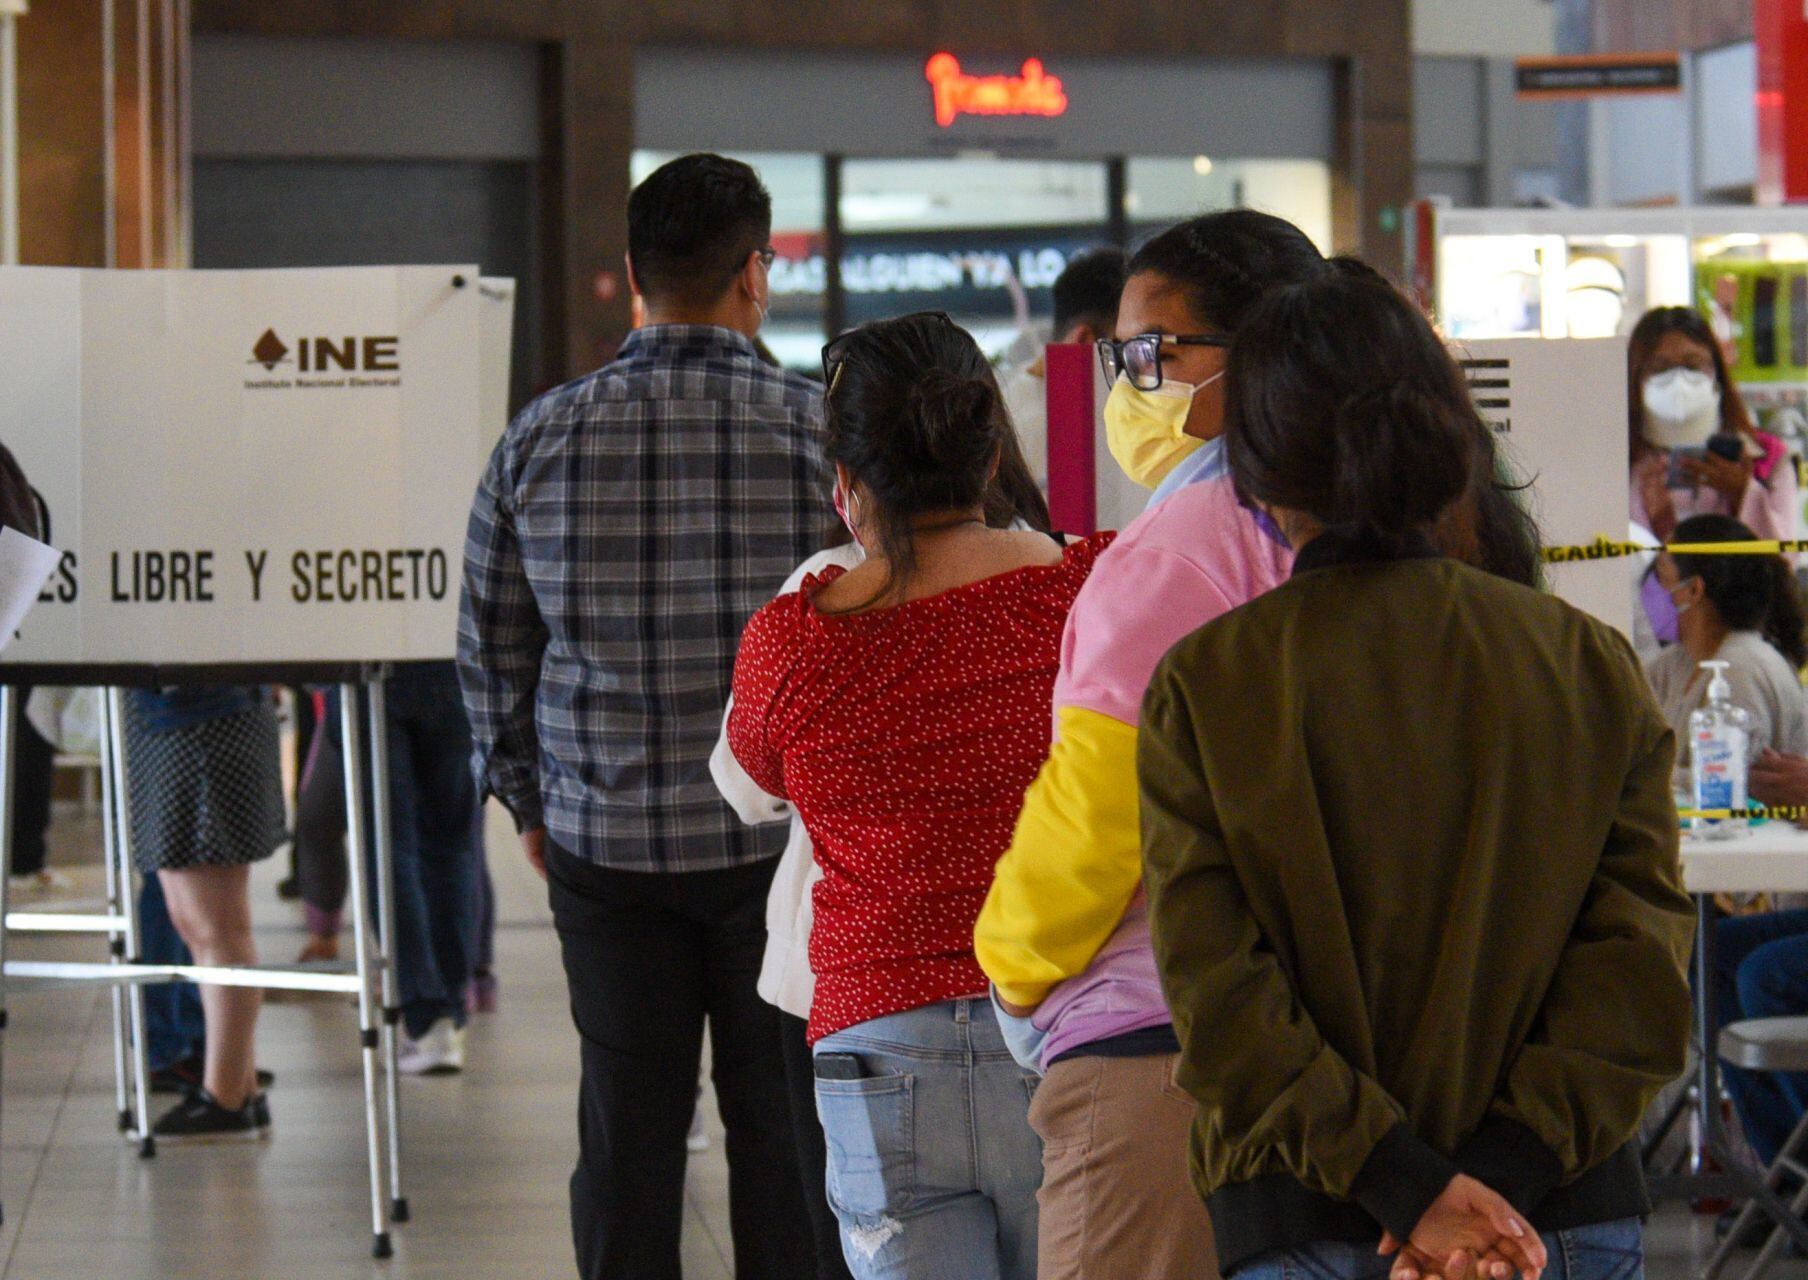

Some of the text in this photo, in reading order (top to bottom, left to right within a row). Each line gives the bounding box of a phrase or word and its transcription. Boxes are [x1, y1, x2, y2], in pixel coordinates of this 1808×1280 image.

[297, 336, 399, 372] INE
[110, 551, 214, 602] LIBRE
[245, 550, 267, 601] Y
[291, 548, 447, 602] SECRETO
